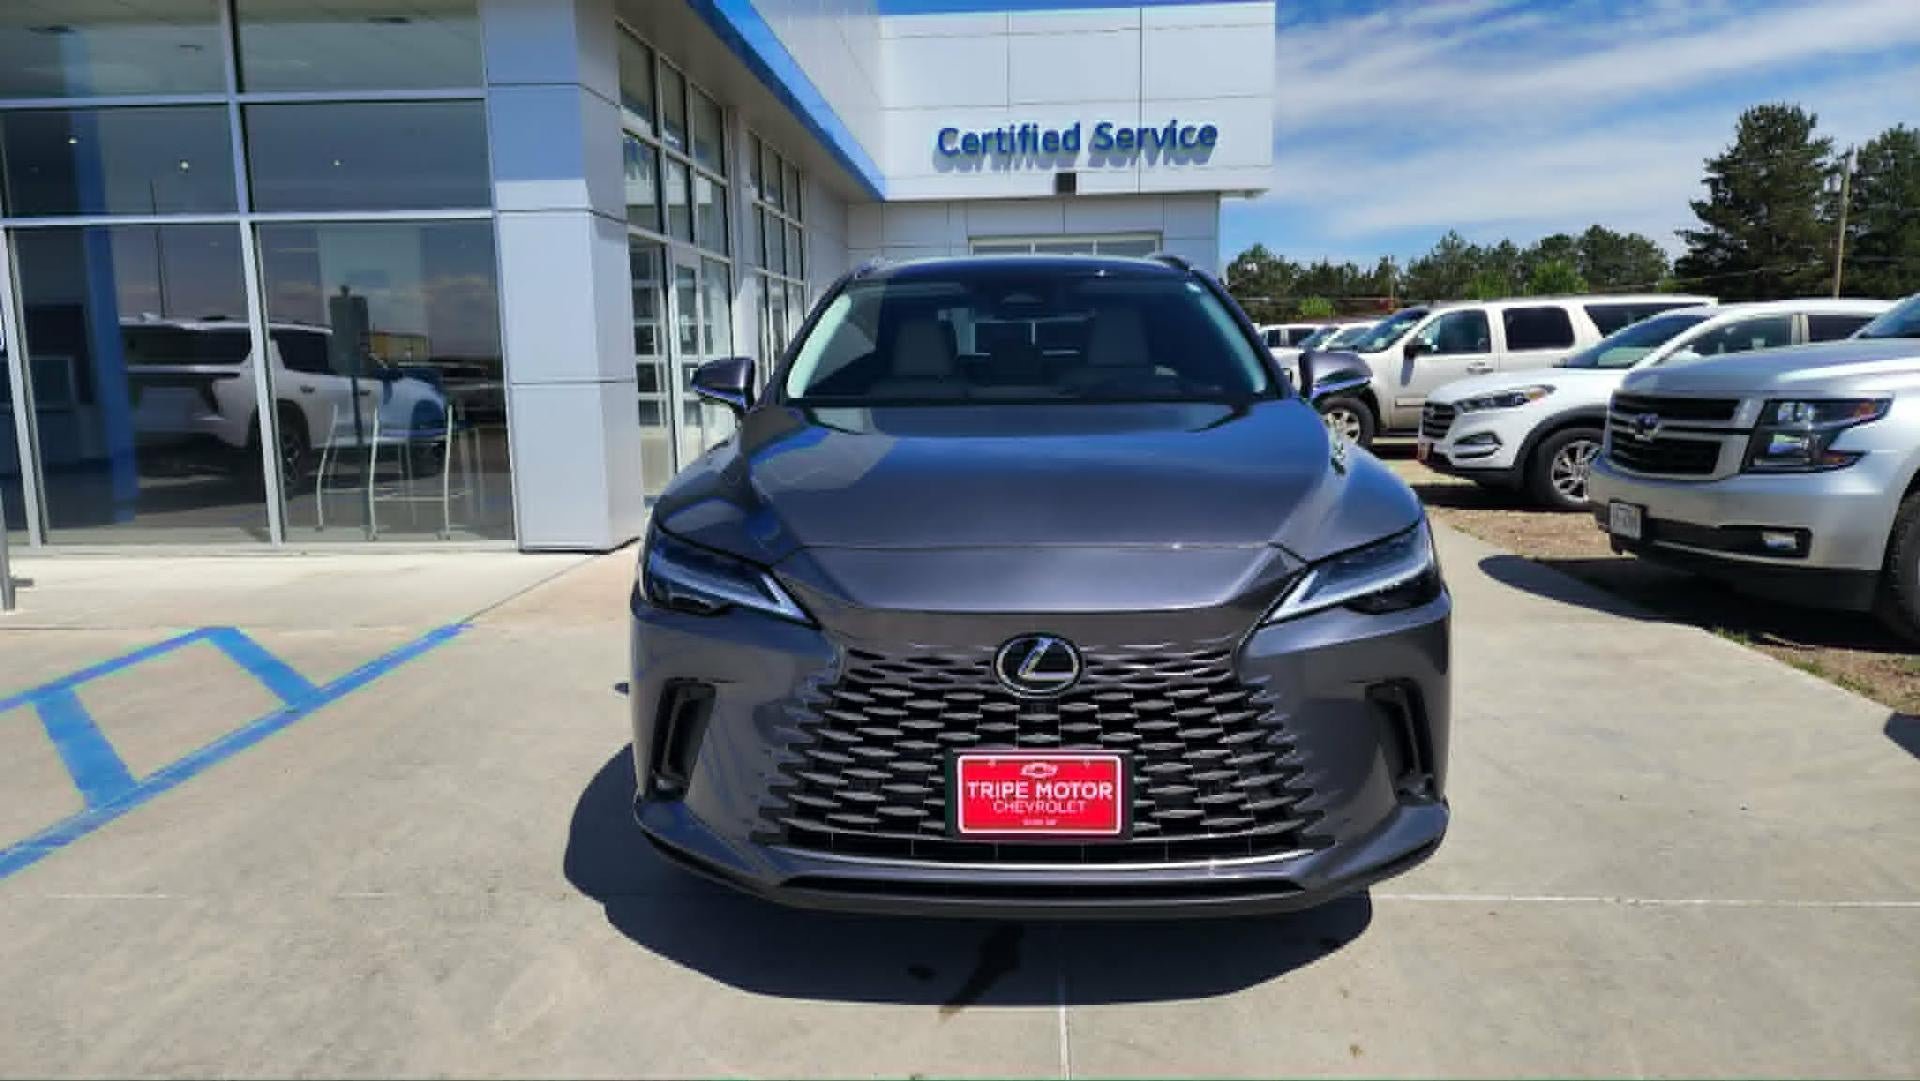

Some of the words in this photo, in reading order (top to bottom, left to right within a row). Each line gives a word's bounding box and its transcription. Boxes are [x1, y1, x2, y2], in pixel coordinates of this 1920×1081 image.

[937, 121, 1082, 155] Certified
[1094, 119, 1218, 150] Service
[967, 780, 1029, 800] TRIPE
[1034, 780, 1113, 800] MOTOR
[992, 800, 1087, 814] CHEVROLET
